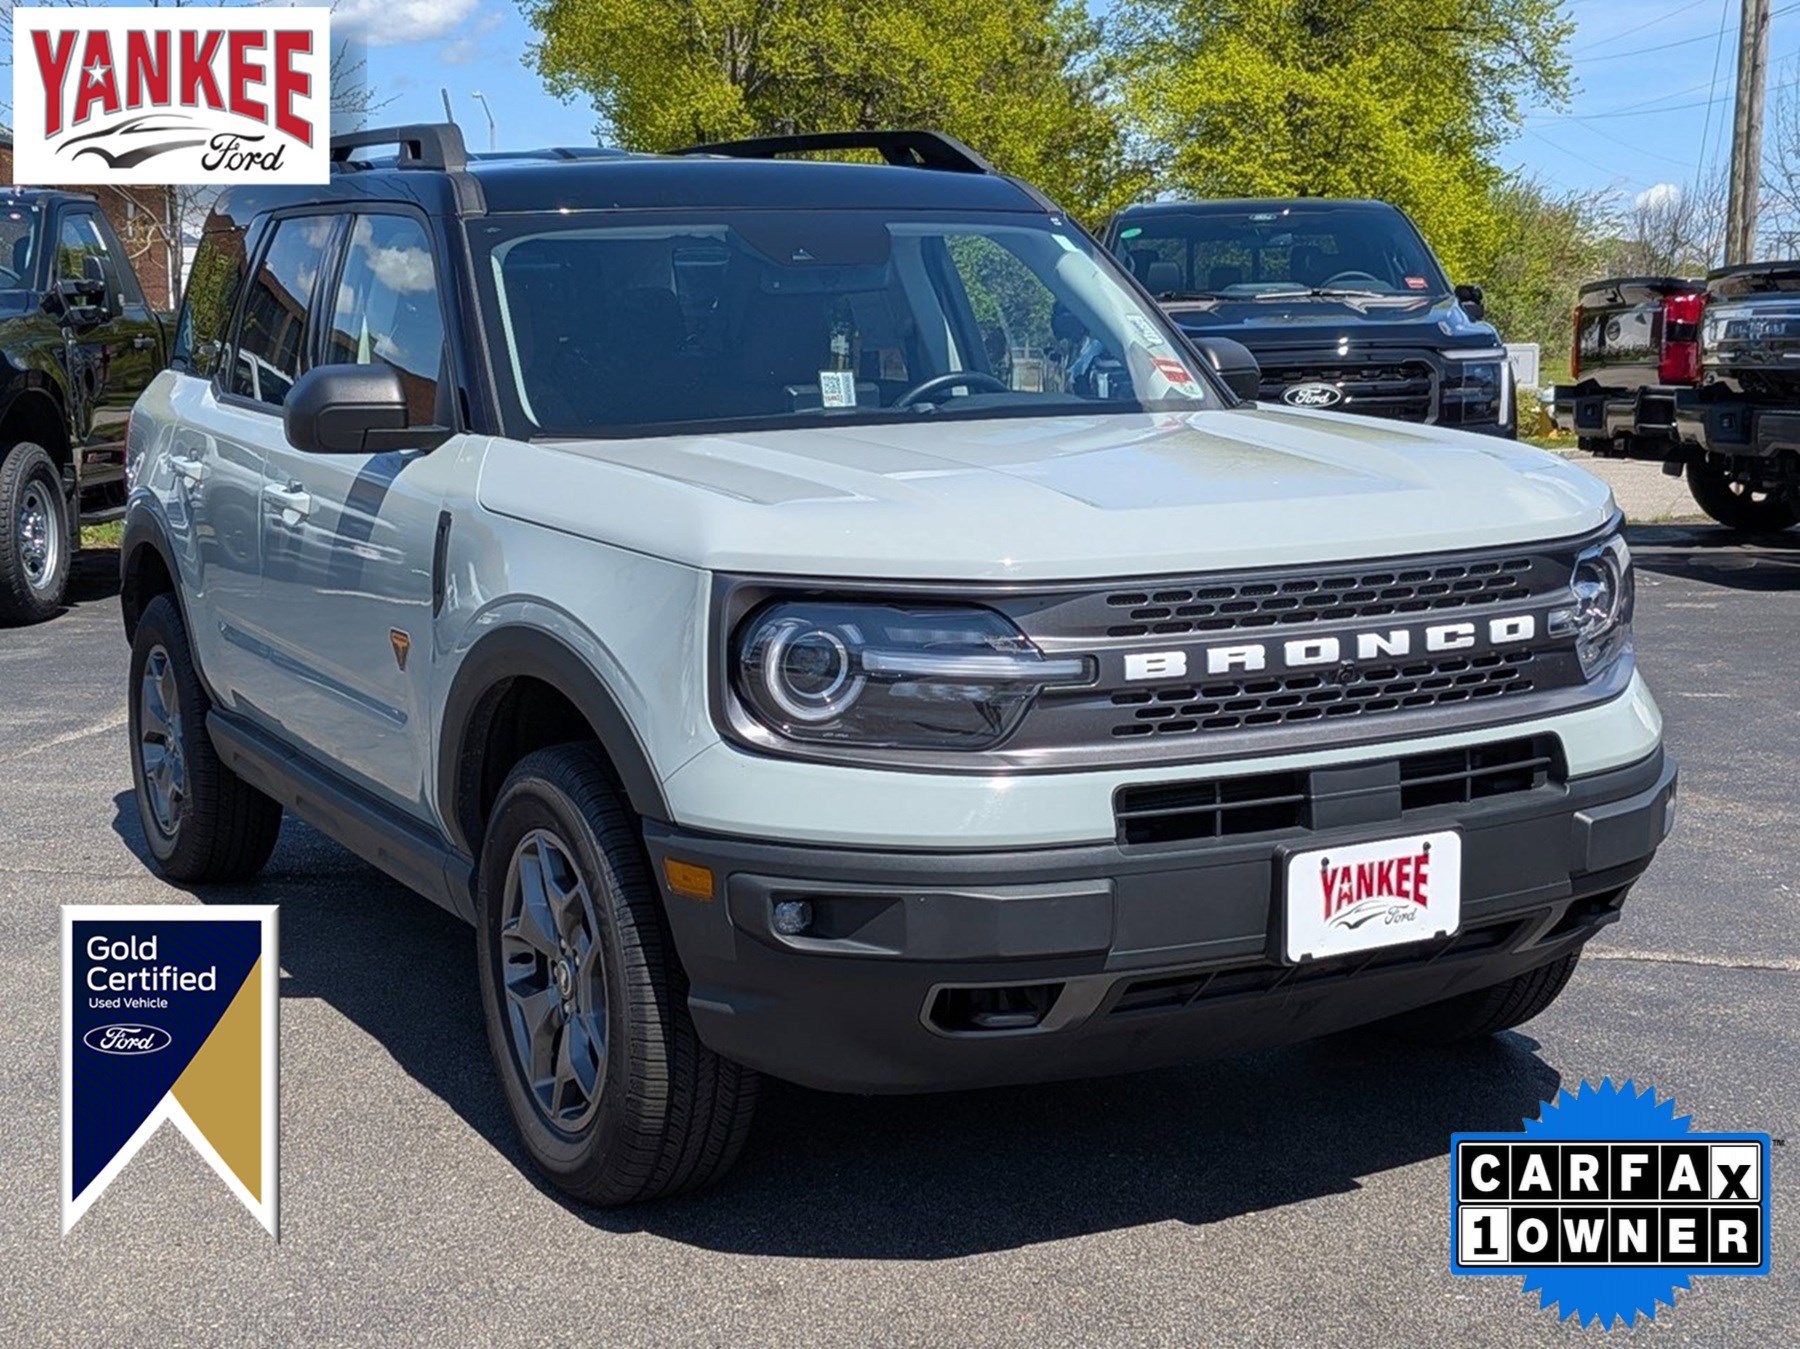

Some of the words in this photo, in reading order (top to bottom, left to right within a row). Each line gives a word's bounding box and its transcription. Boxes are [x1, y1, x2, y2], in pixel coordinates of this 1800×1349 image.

[1295, 389, 1330, 404] Ford
[1124, 615, 1534, 681] BRONCO
[1319, 853, 1429, 921] YANKEE
[1384, 904, 1417, 925] Ford
